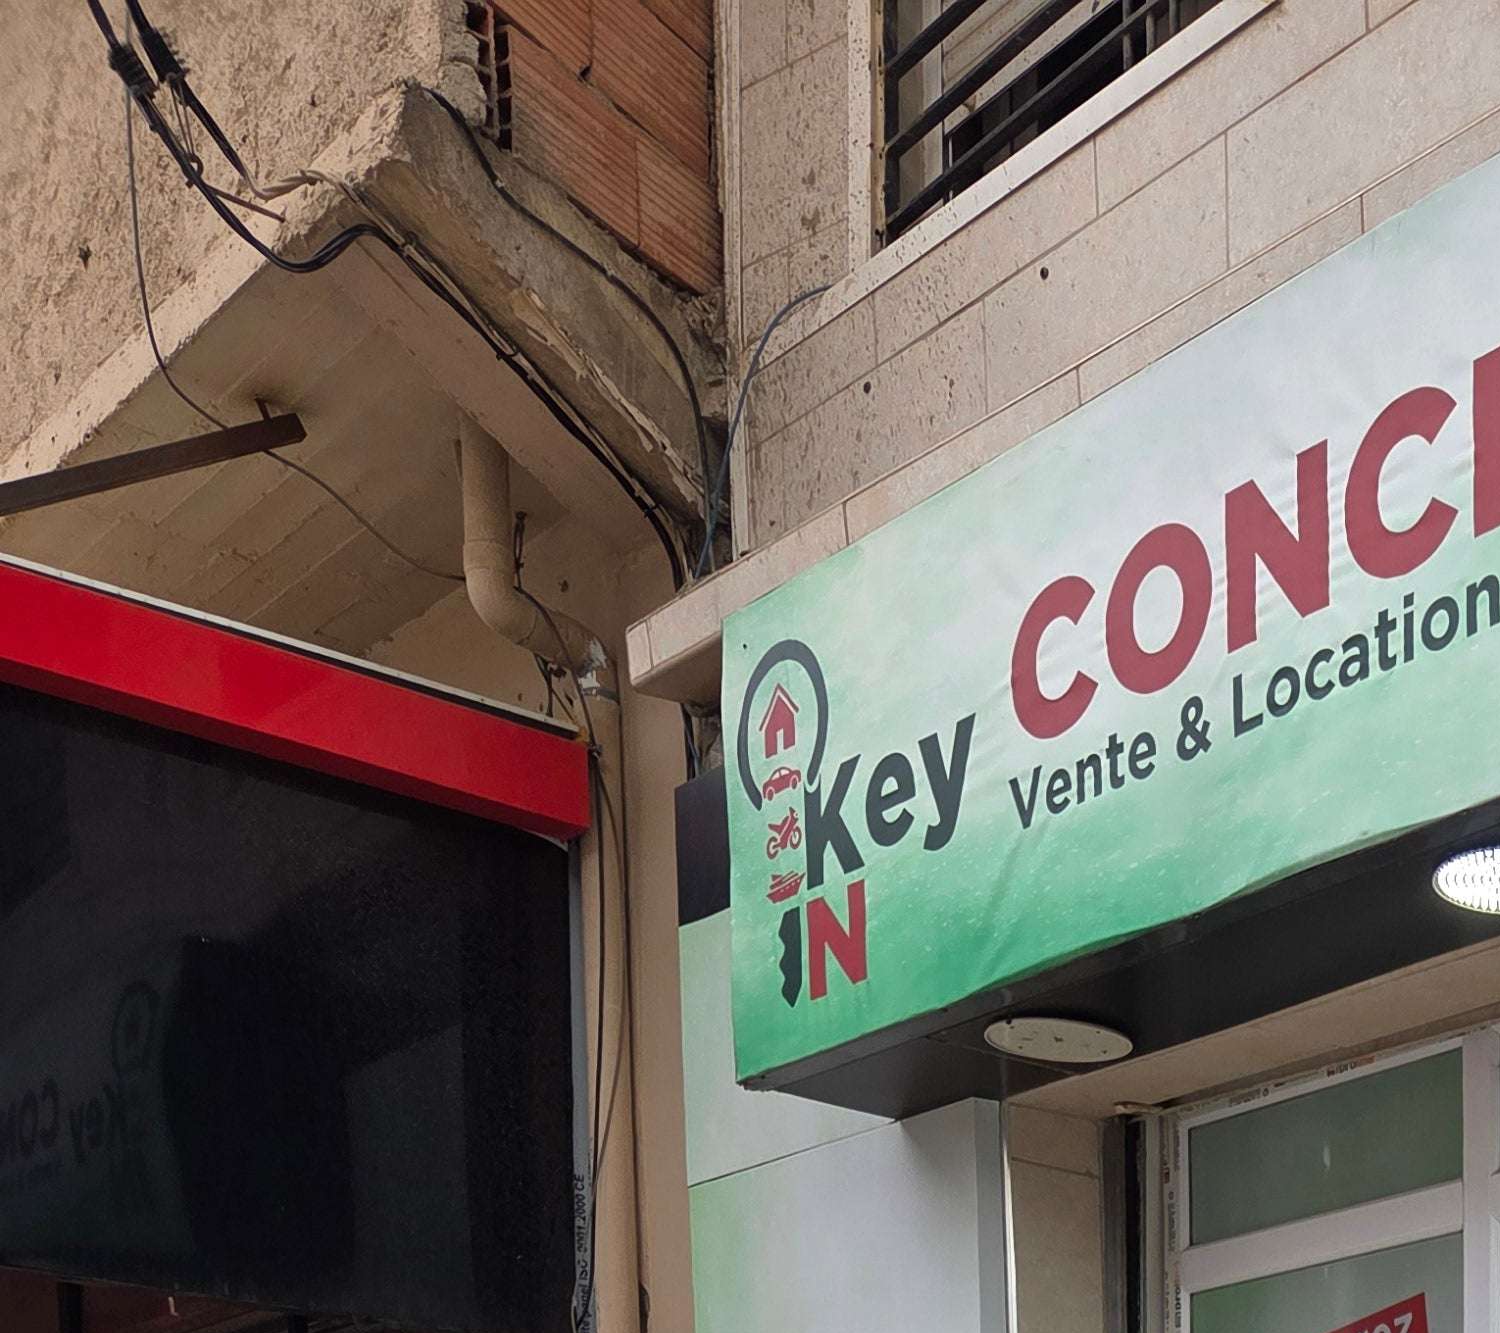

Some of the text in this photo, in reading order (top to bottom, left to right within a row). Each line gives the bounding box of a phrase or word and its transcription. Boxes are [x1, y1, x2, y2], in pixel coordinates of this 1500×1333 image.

[804, 712, 977, 890] Key
[1008, 730, 1157, 829] Vente
[1176, 695, 1211, 760] &
